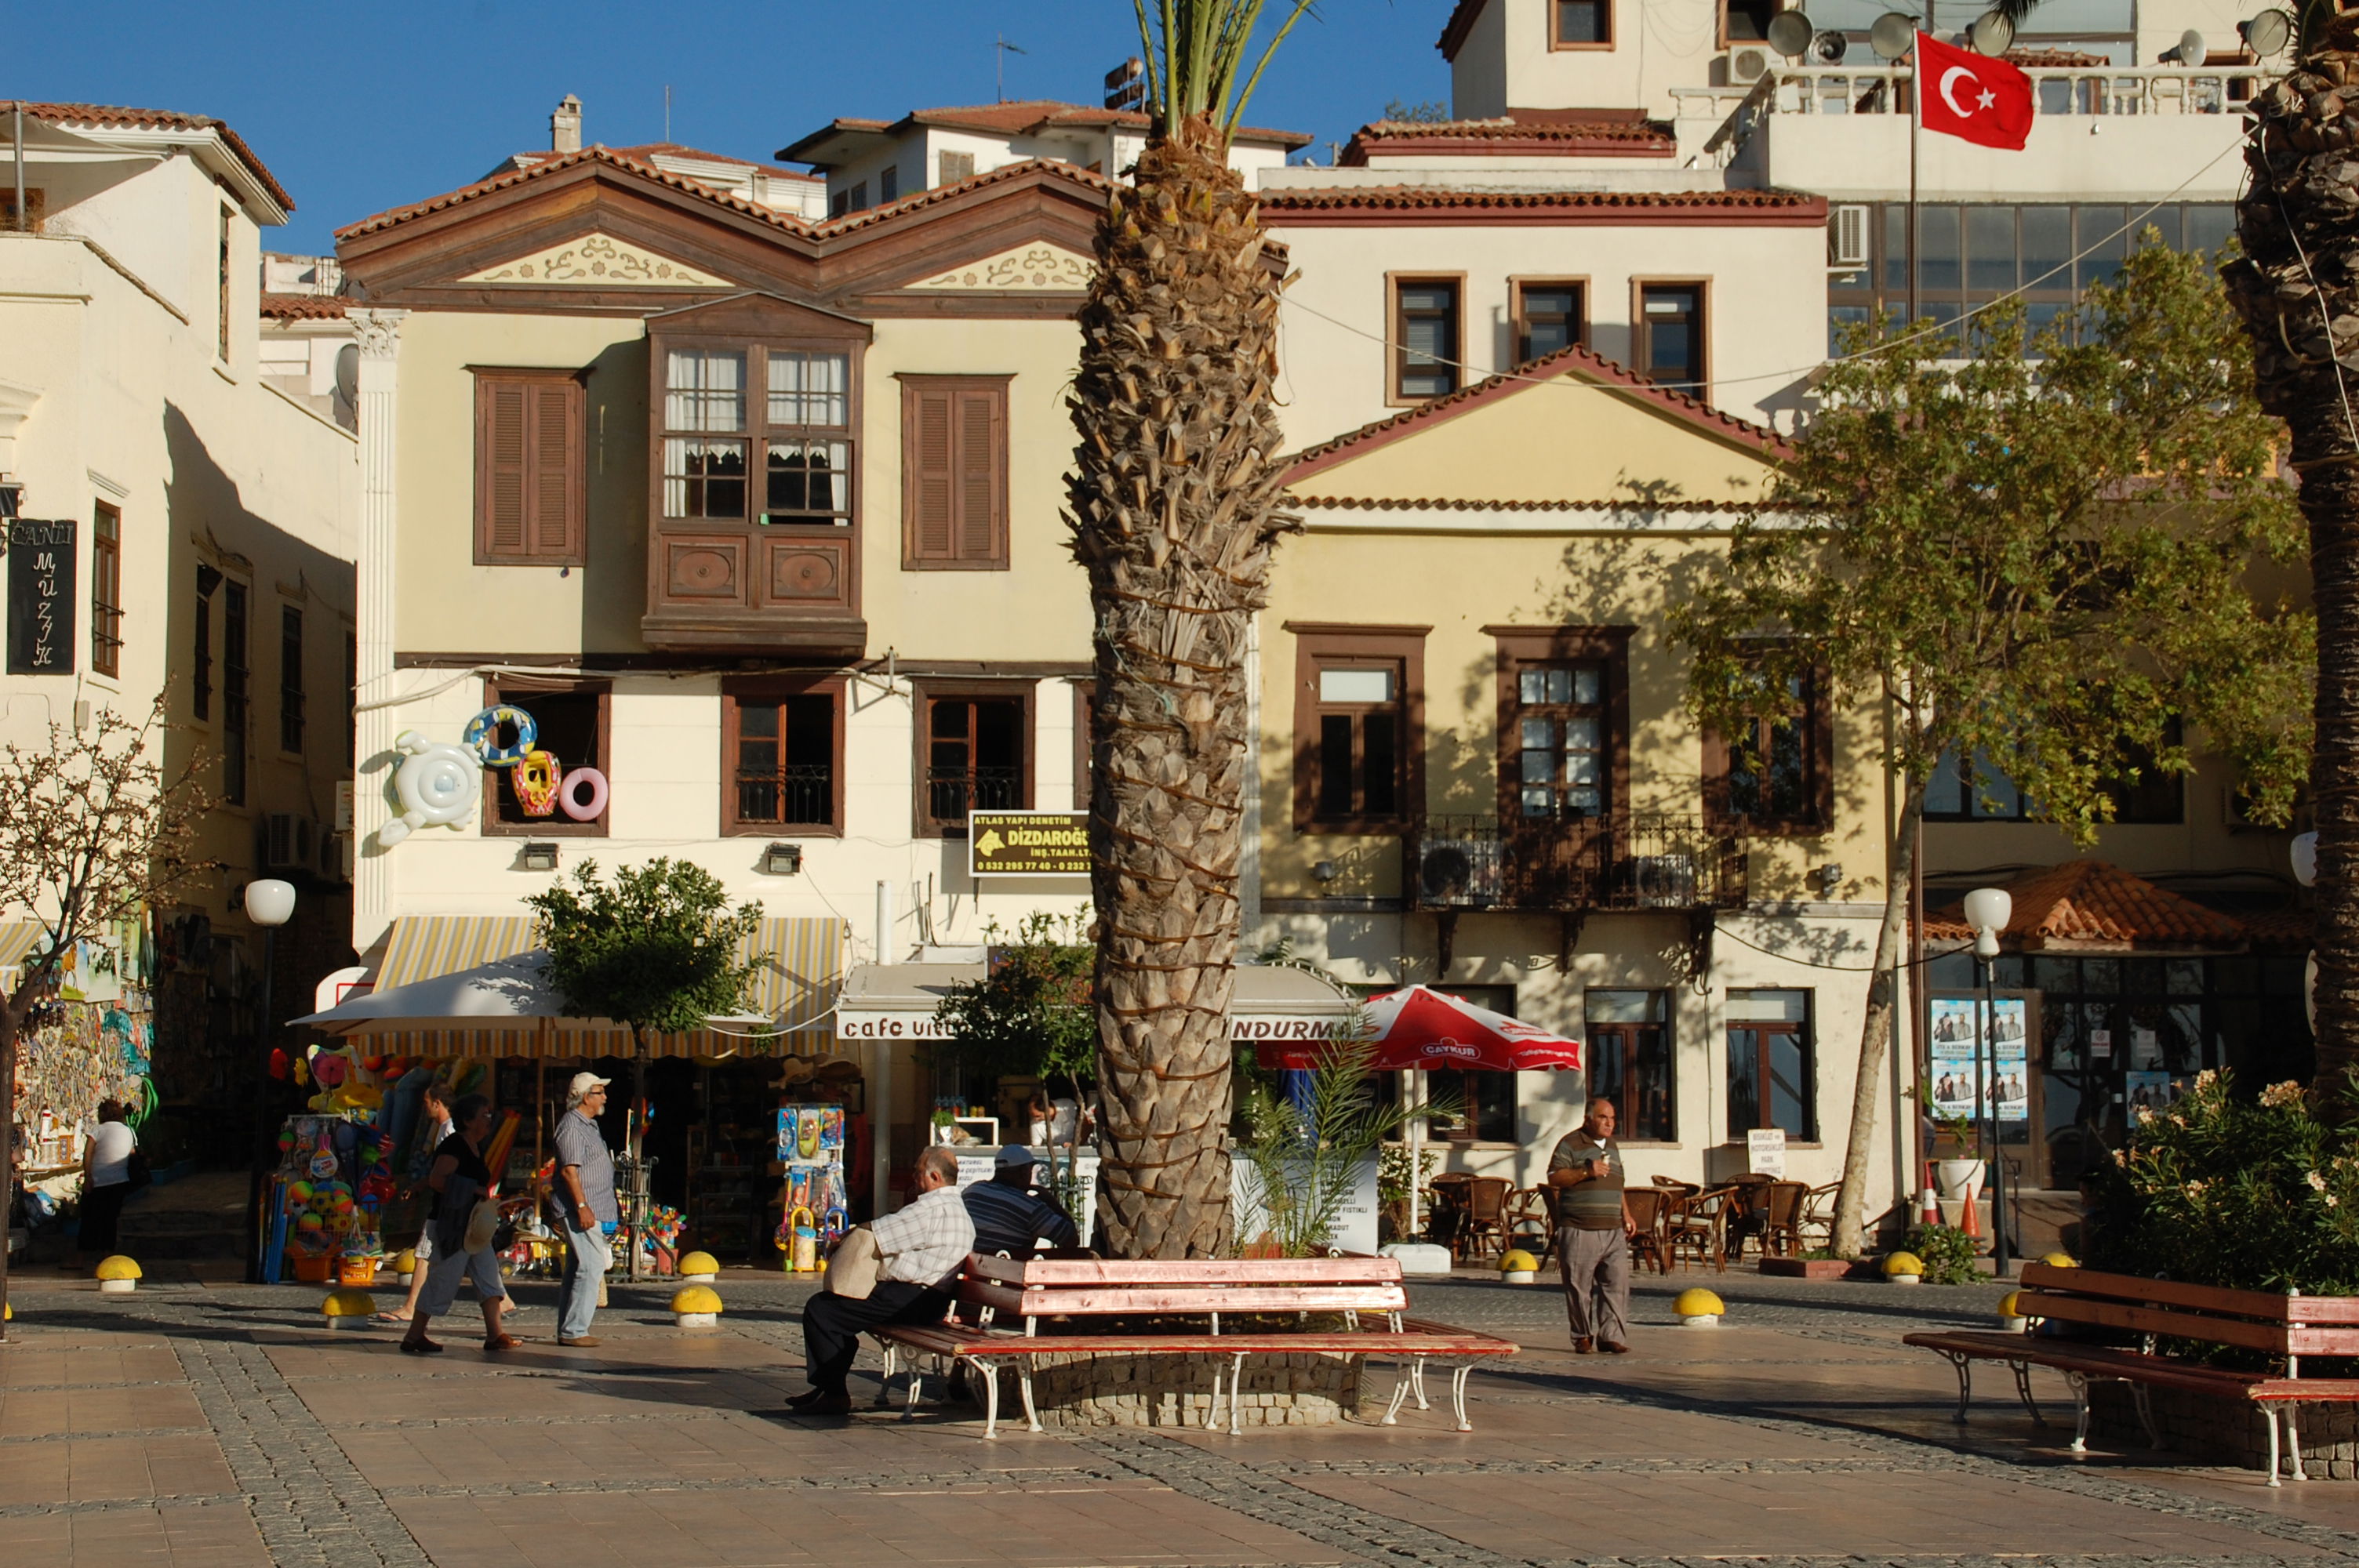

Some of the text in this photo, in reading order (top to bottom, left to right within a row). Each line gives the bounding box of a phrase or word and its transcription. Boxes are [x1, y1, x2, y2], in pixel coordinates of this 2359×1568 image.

[974, 815, 1071, 826] ATLAS YAPI DENETİM
[845, 1018, 903, 1037] cafe
